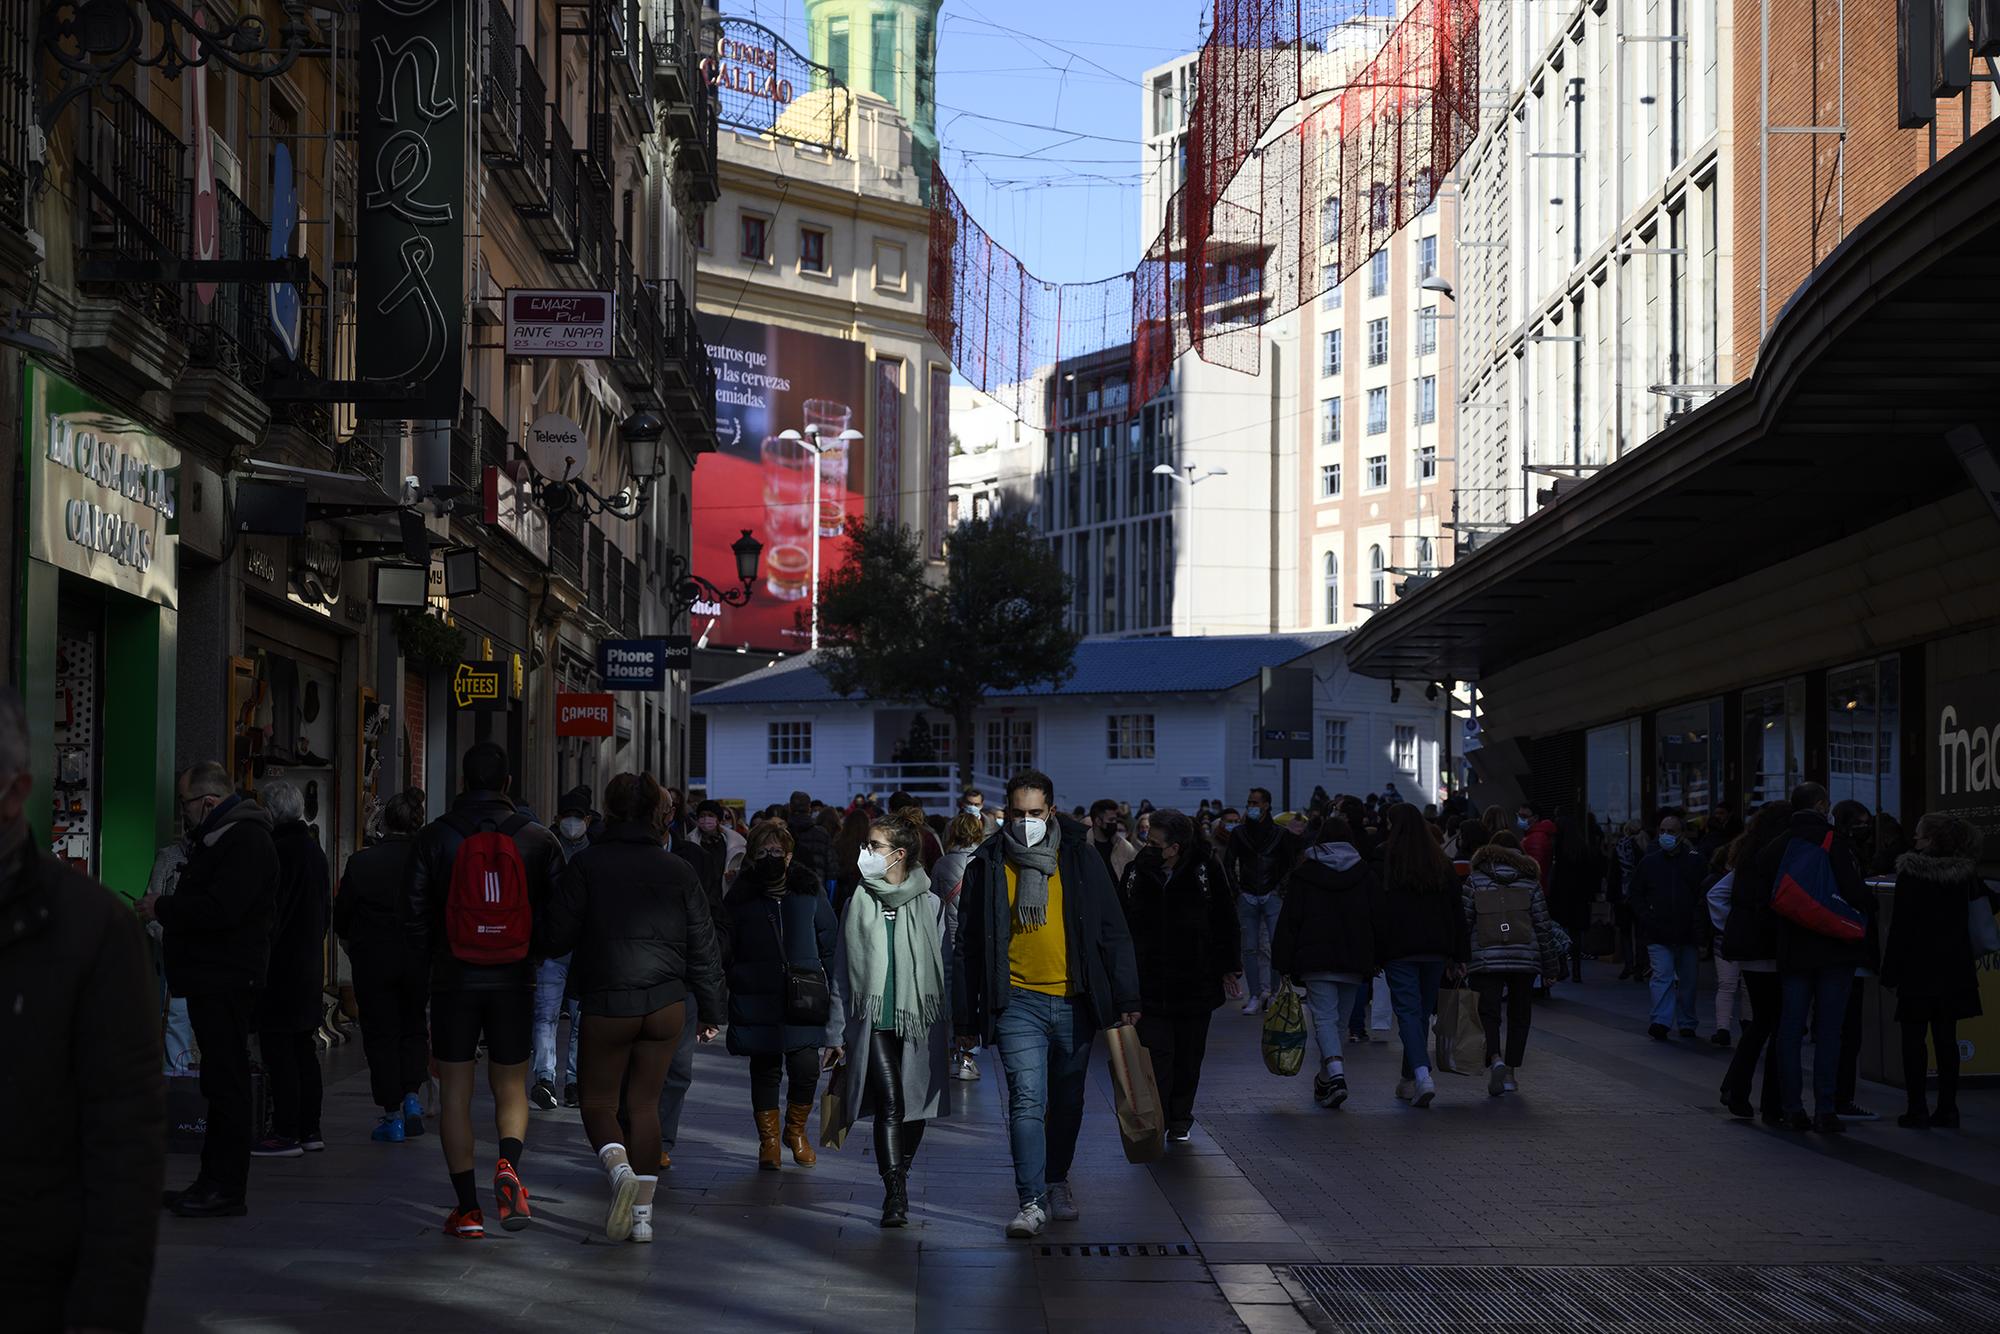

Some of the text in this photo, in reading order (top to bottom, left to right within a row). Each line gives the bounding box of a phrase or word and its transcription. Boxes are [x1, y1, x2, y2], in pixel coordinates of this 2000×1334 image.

[717, 37, 776, 71] CINES
[700, 57, 793, 104] CALLAO
[364, 0, 456, 384] nes
[531, 298, 581, 312] EMART
[514, 326, 604, 338] ANTE NAPA
[546, 340, 577, 348] PISO
[704, 343, 767, 369] entros que
[723, 363, 740, 384] las
[741, 371, 791, 392] cervezas
[715, 386, 766, 409] emiadas.
[533, 430, 577, 443] Televés
[47, 413, 75, 470] LA
[76, 431, 121, 491] CASA
[66, 499, 150, 574] CARCASAS
[606, 648, 655, 663] Phone
[606, 663, 655, 678] House
[561, 706, 608, 723] CAMPER
